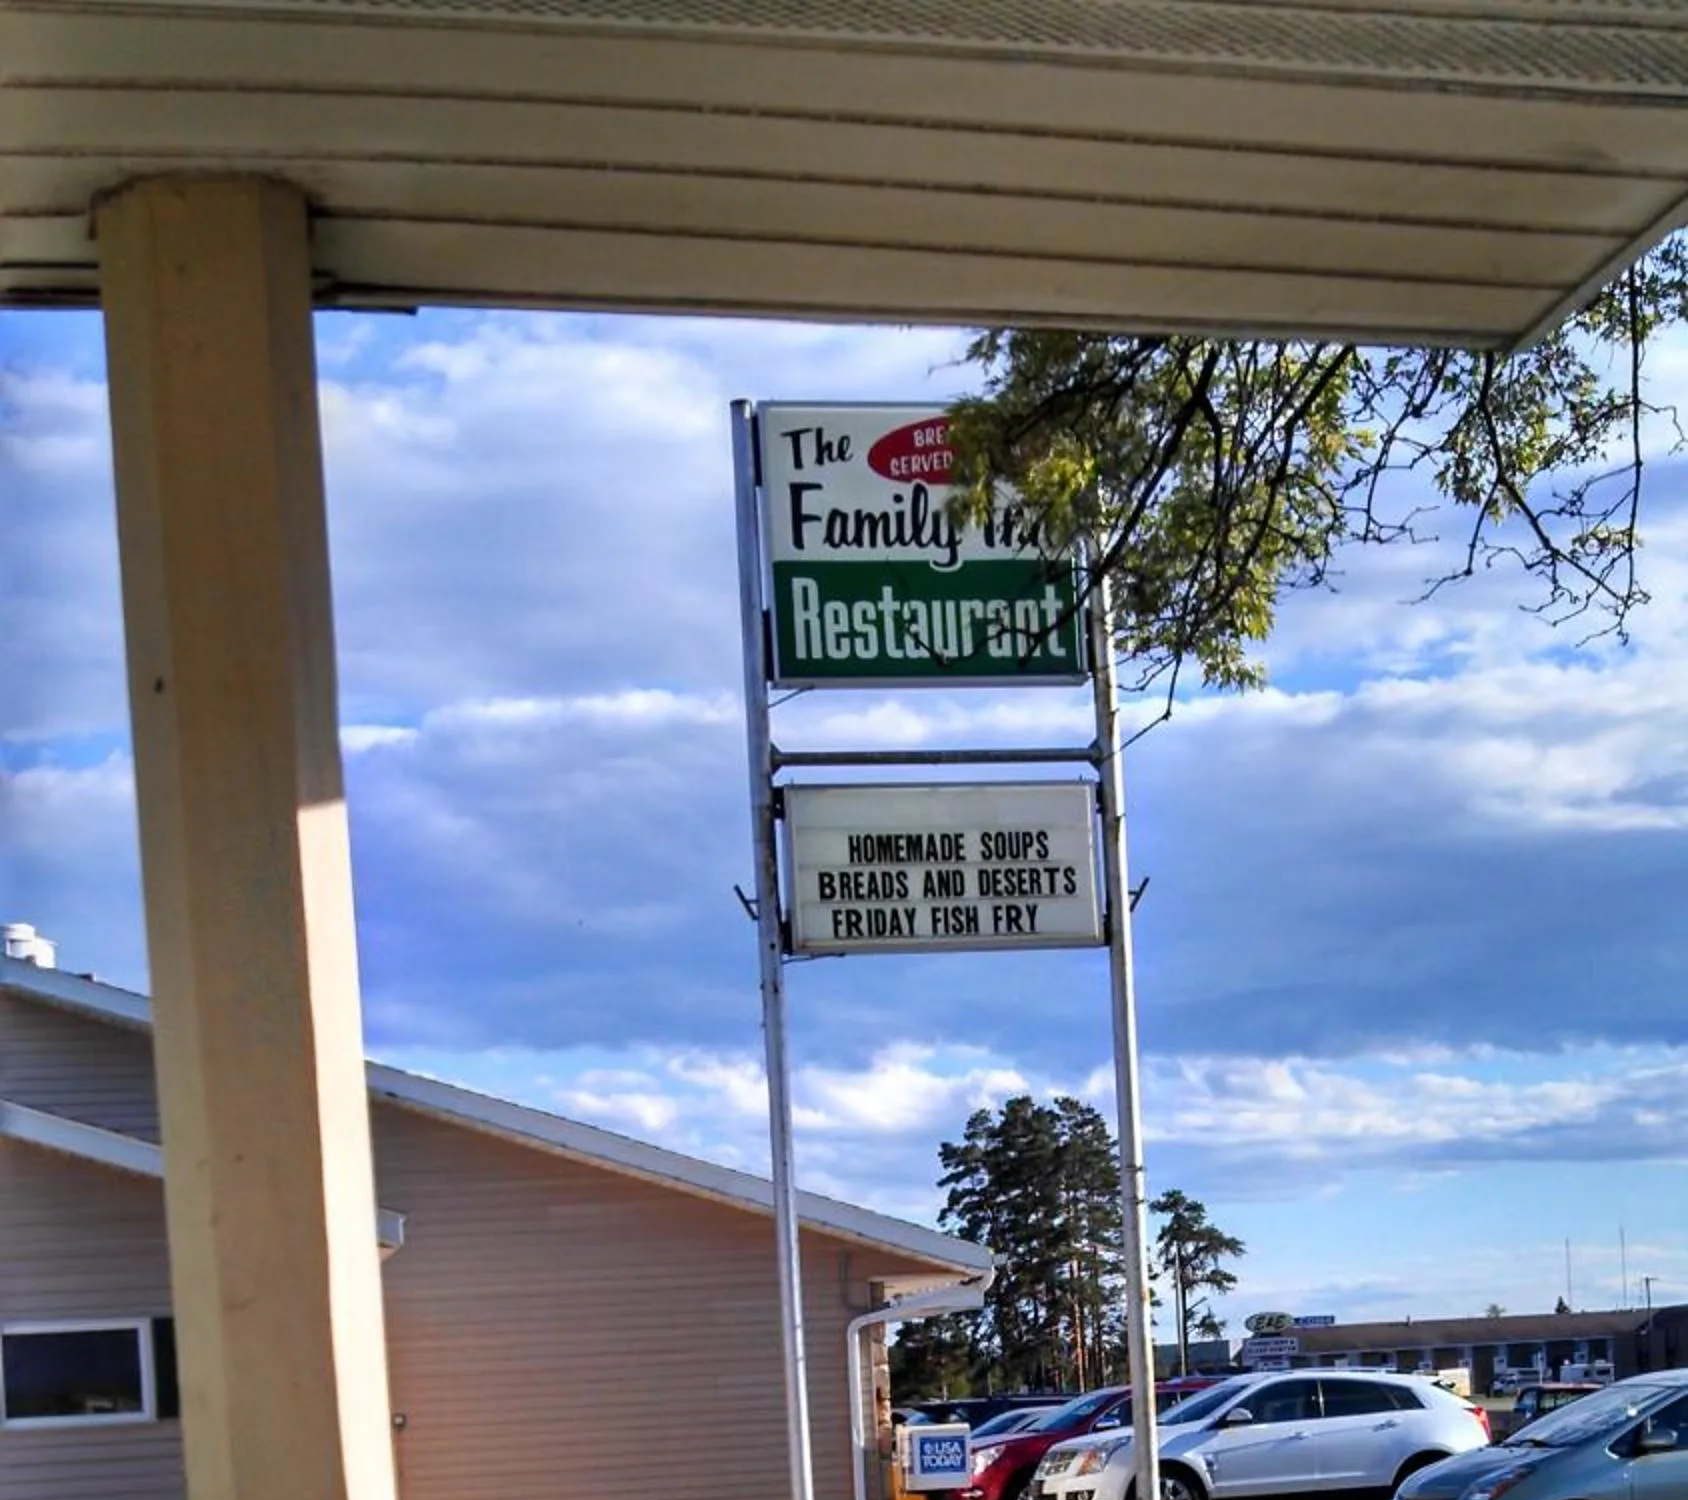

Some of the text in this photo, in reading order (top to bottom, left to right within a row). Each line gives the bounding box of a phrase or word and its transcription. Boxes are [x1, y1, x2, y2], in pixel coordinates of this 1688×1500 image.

[781, 427, 853, 470] The
[789, 482, 962, 567] Family
[791, 577, 1067, 660] Restaurant
[848, 831, 1049, 864] HOMEMADE SOUPS
[818, 866, 1077, 901] BREADS AND DESERTS
[832, 904, 1039, 938] FRIDAY FISH FRY
[922, 1454, 963, 1468] TODAY
[935, 1440, 961, 1453] USA
